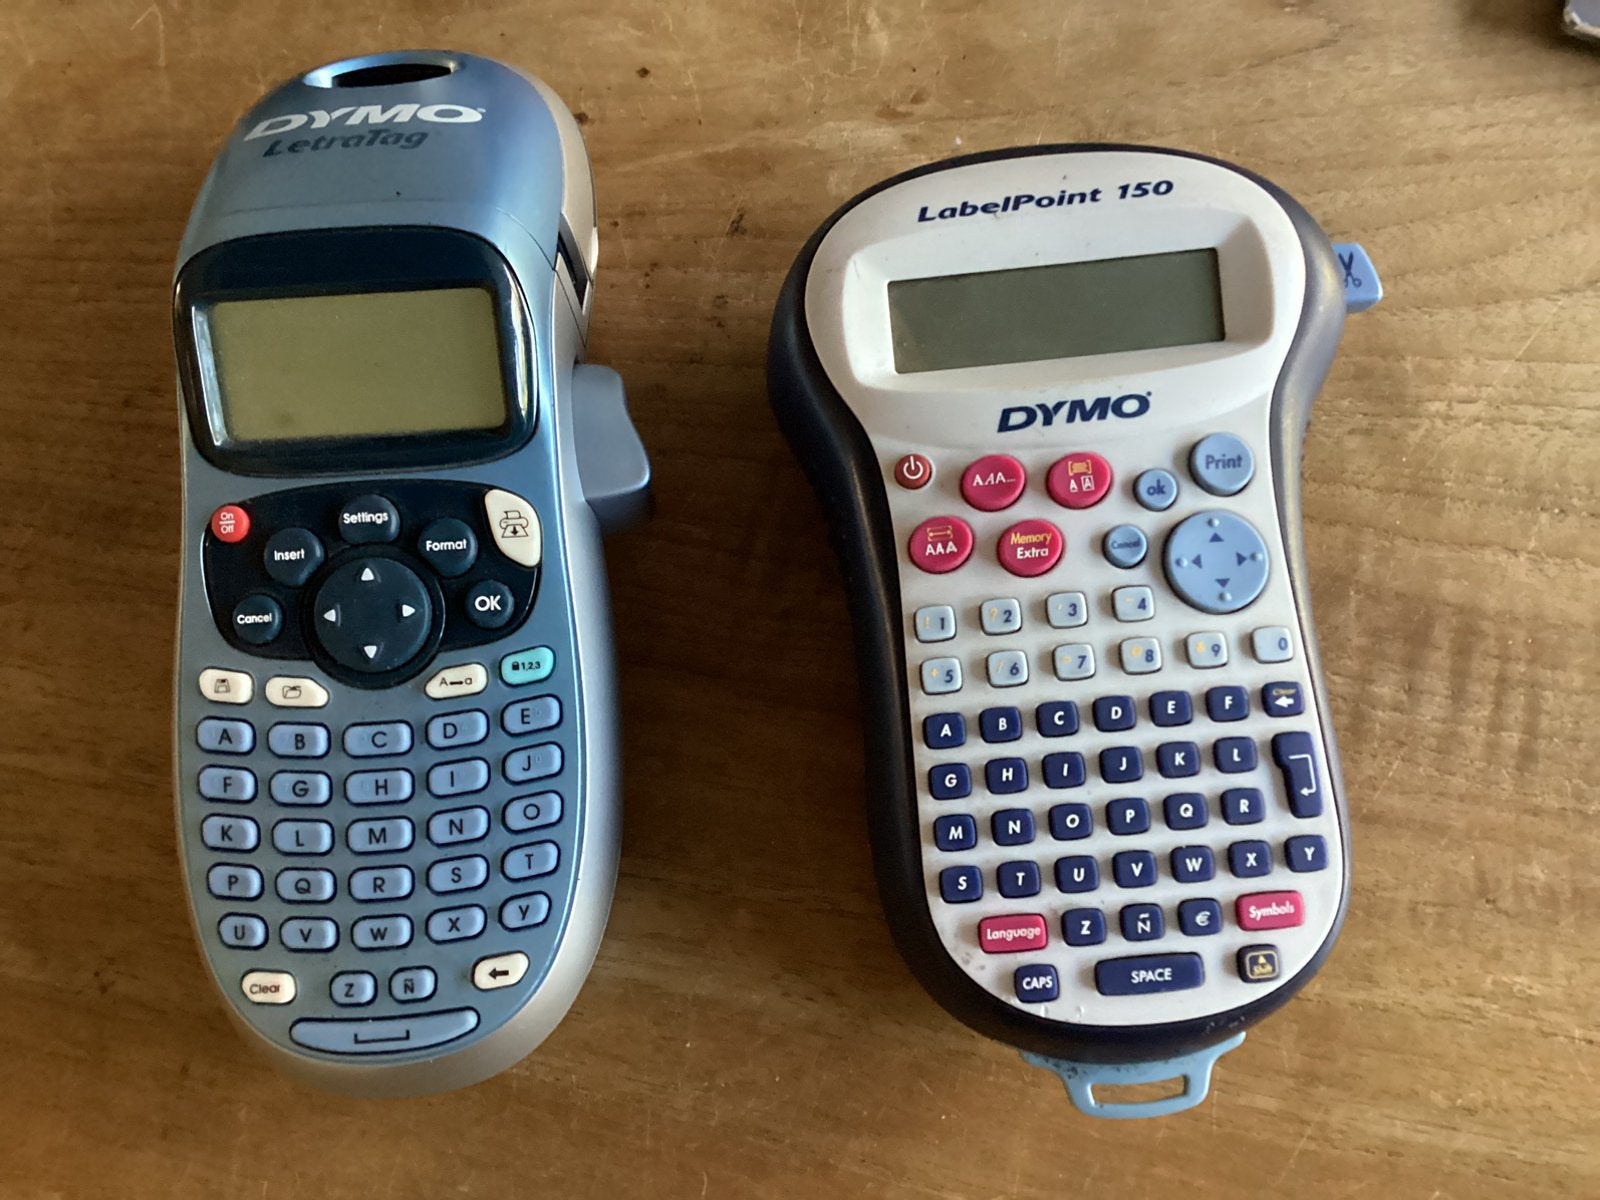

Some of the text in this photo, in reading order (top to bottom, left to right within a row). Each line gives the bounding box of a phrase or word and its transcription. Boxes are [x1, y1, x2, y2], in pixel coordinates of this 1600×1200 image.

[244, 104, 483, 142] DYMO
[263, 128, 428, 158] LetraTag
[917, 180, 1174, 223] LabelPoint 150
[997, 393, 1150, 433] DYMO
[1205, 454, 1242, 470] Print
[221, 512, 234, 520] On
[343, 511, 388, 524] Settings
[221, 525, 233, 534] Off
[426, 538, 467, 552] Format
[1010, 532, 1051, 546] Memory
[274, 547, 305, 560] Insert
[925, 542, 958, 555] AAA
[1016, 545, 1049, 560] Extra
[474, 597, 501, 611] OK
[1068, 603, 1077, 616] 3
[1138, 598, 1146, 610] 4
[237, 613, 272, 624] Cancel
[1003, 610, 1012, 623] 2
[939, 618, 945, 630] 1
[1211, 643, 1221, 656] 9
[1278, 638, 1288, 651] 0
[1078, 655, 1087, 669] 7
[1145, 649, 1154, 662] 8
[1010, 663, 1020, 675] 6
[945, 670, 954, 683] 5
[1168, 701, 1175, 713] E
[1225, 696, 1232, 709] F
[521, 708, 530, 724] E
[1054, 711, 1064, 725] C
[1112, 707, 1121, 719] D
[443, 723, 457, 739] D
[941, 724, 951, 737] A
[999, 718, 1007, 730] B
[219, 729, 232, 744] A
[295, 734, 305, 750] B
[372, 731, 387, 748] C
[1175, 752, 1184, 765] K
[1233, 749, 1240, 761] L
[522, 755, 531, 771] J
[1063, 764, 1068, 776] I
[1120, 757, 1126, 770] J
[451, 771, 454, 787] I
[945, 774, 957, 787] G
[1003, 768, 1013, 781] H
[223, 777, 232, 793] F
[292, 780, 309, 797] G
[375, 779, 388, 795] H
[523, 803, 540, 820] O
[1180, 804, 1193, 817] Q
[1240, 799, 1249, 812] R
[1066, 814, 1079, 828] O
[1126, 810, 1135, 823] P
[221, 825, 232, 841] K
[449, 819, 463, 835] N
[949, 826, 962, 840] M
[1009, 820, 1020, 834] N
[296, 830, 304, 847] L
[369, 827, 386, 844] M
[1247, 853, 1256, 867] X
[1305, 847, 1314, 860] Y
[525, 854, 533, 869] T
[1186, 858, 1202, 871] W
[452, 867, 461, 883] S
[1074, 868, 1084, 881] U
[1132, 863, 1142, 876] V
[228, 875, 239, 891] P
[295, 878, 311, 894] Q
[373, 877, 385, 893] R
[958, 876, 966, 890] S
[1017, 873, 1025, 885] T
[519, 905, 529, 920] Y
[1249, 901, 1294, 921] Symbols
[448, 917, 460, 932] X
[1081, 921, 1090, 934] Z
[1138, 914, 1150, 933] Ñ
[234, 925, 245, 940] U
[300, 928, 312, 942] V
[370, 927, 387, 941] W
[987, 924, 1041, 942] Language
[1131, 968, 1172, 983] SPACE
[249, 983, 281, 994] Clear
[344, 983, 354, 997] Z
[404, 979, 414, 994] Ñ
[1023, 976, 1053, 990] CAPS
